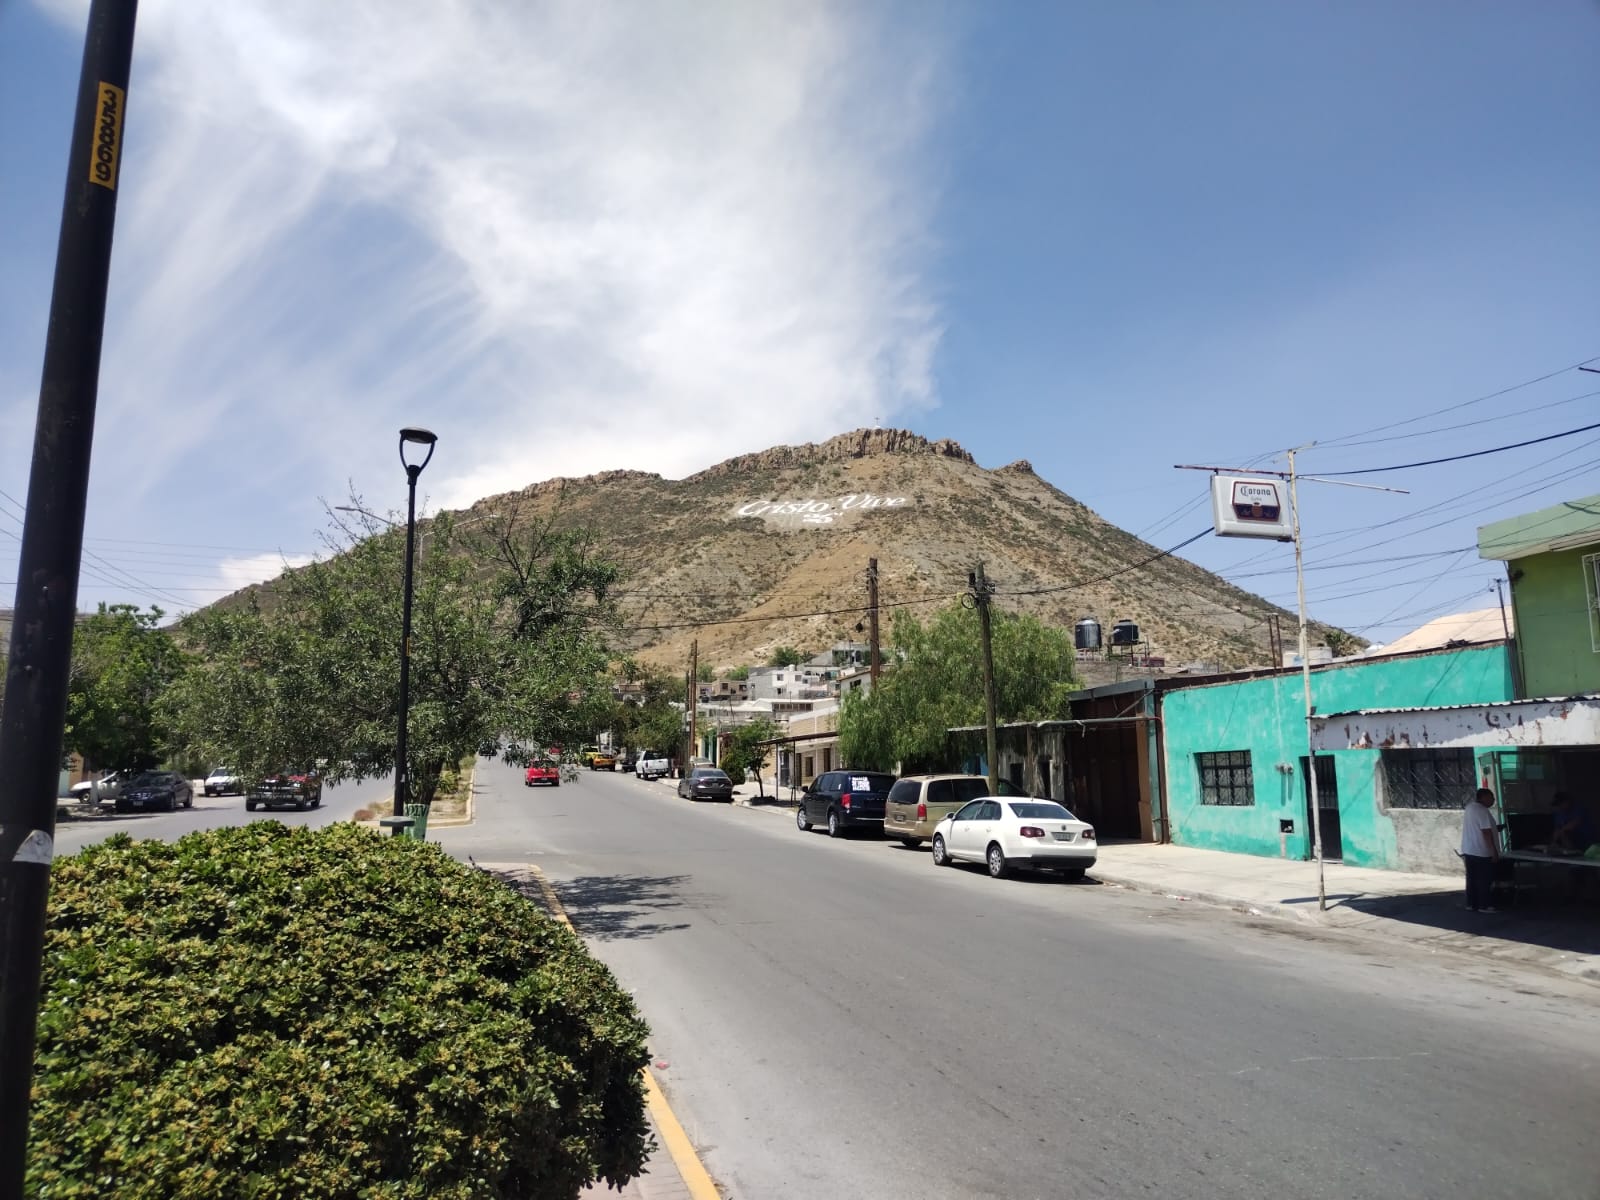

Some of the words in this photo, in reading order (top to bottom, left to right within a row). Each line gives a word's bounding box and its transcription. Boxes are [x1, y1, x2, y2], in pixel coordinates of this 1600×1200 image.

[95, 89, 117, 182] 35869
[1240, 485, 1271, 496] Corona
[737, 499, 829, 516] Cristo
[838, 494, 906, 510] Vive
